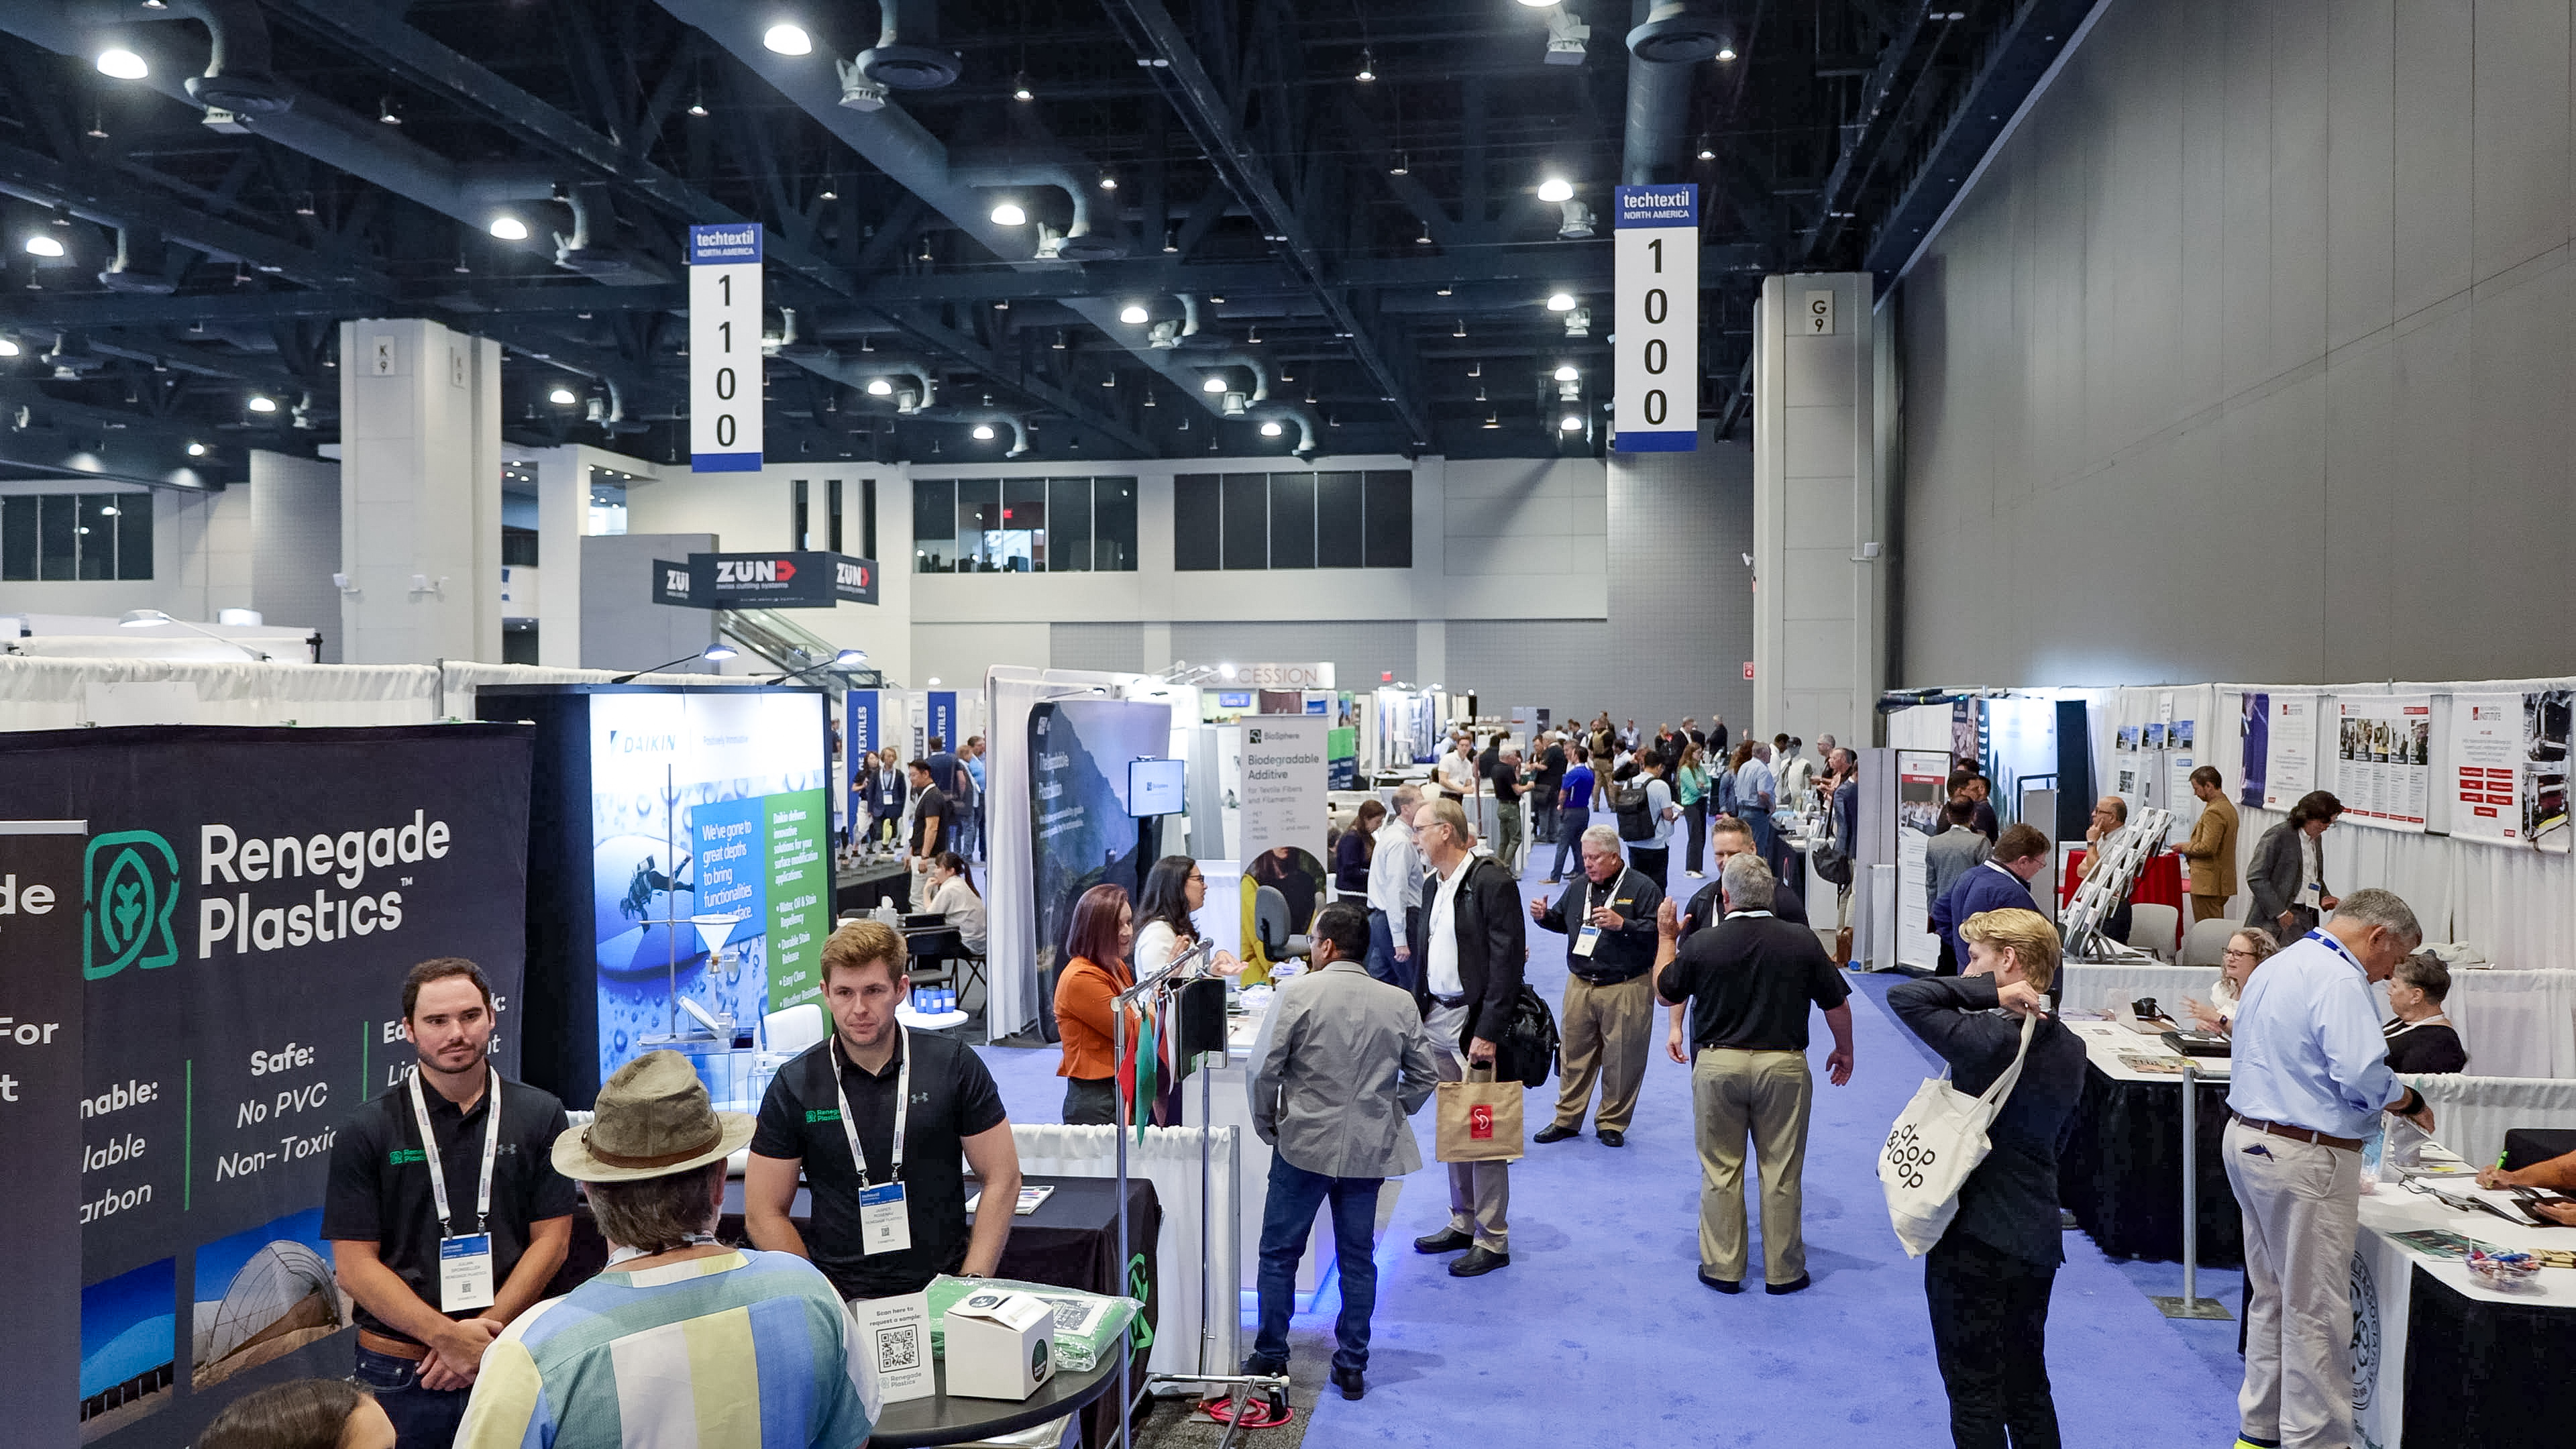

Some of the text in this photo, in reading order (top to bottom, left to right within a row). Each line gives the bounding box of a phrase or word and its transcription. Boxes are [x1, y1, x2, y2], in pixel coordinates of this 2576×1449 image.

[1623, 191, 1689, 209] techtextil
[1623, 210, 1690, 219] NORTH AMERICA
[696, 229, 754, 247] techtextil
[1812, 300, 1826, 315] G
[1815, 318, 1824, 333] 9
[379, 344, 388, 357] K
[380, 360, 388, 373] 9
[857, 706, 867, 755] TEXTILES
[625, 735, 676, 753] DAIKIN
[1248, 754, 1320, 766] Biodegradable
[1248, 769, 1289, 780] Additive
[702, 820, 753, 841] We've gone to
[201, 809, 450, 890] Renegade
[703, 841, 748, 867] great depths
[703, 866, 733, 886] to bring
[704, 883, 752, 908] functionalities
[251, 1042, 314, 1077] Safe:
[237, 1081, 328, 1128] No PVC
[1901, 1122, 1936, 1167] drop
[1887, 1140, 1923, 1189] loop
[869, 1318, 892, 1326] request
[890, 1372, 922, 1381] Renegade
[891, 1380, 916, 1388] Plastics
